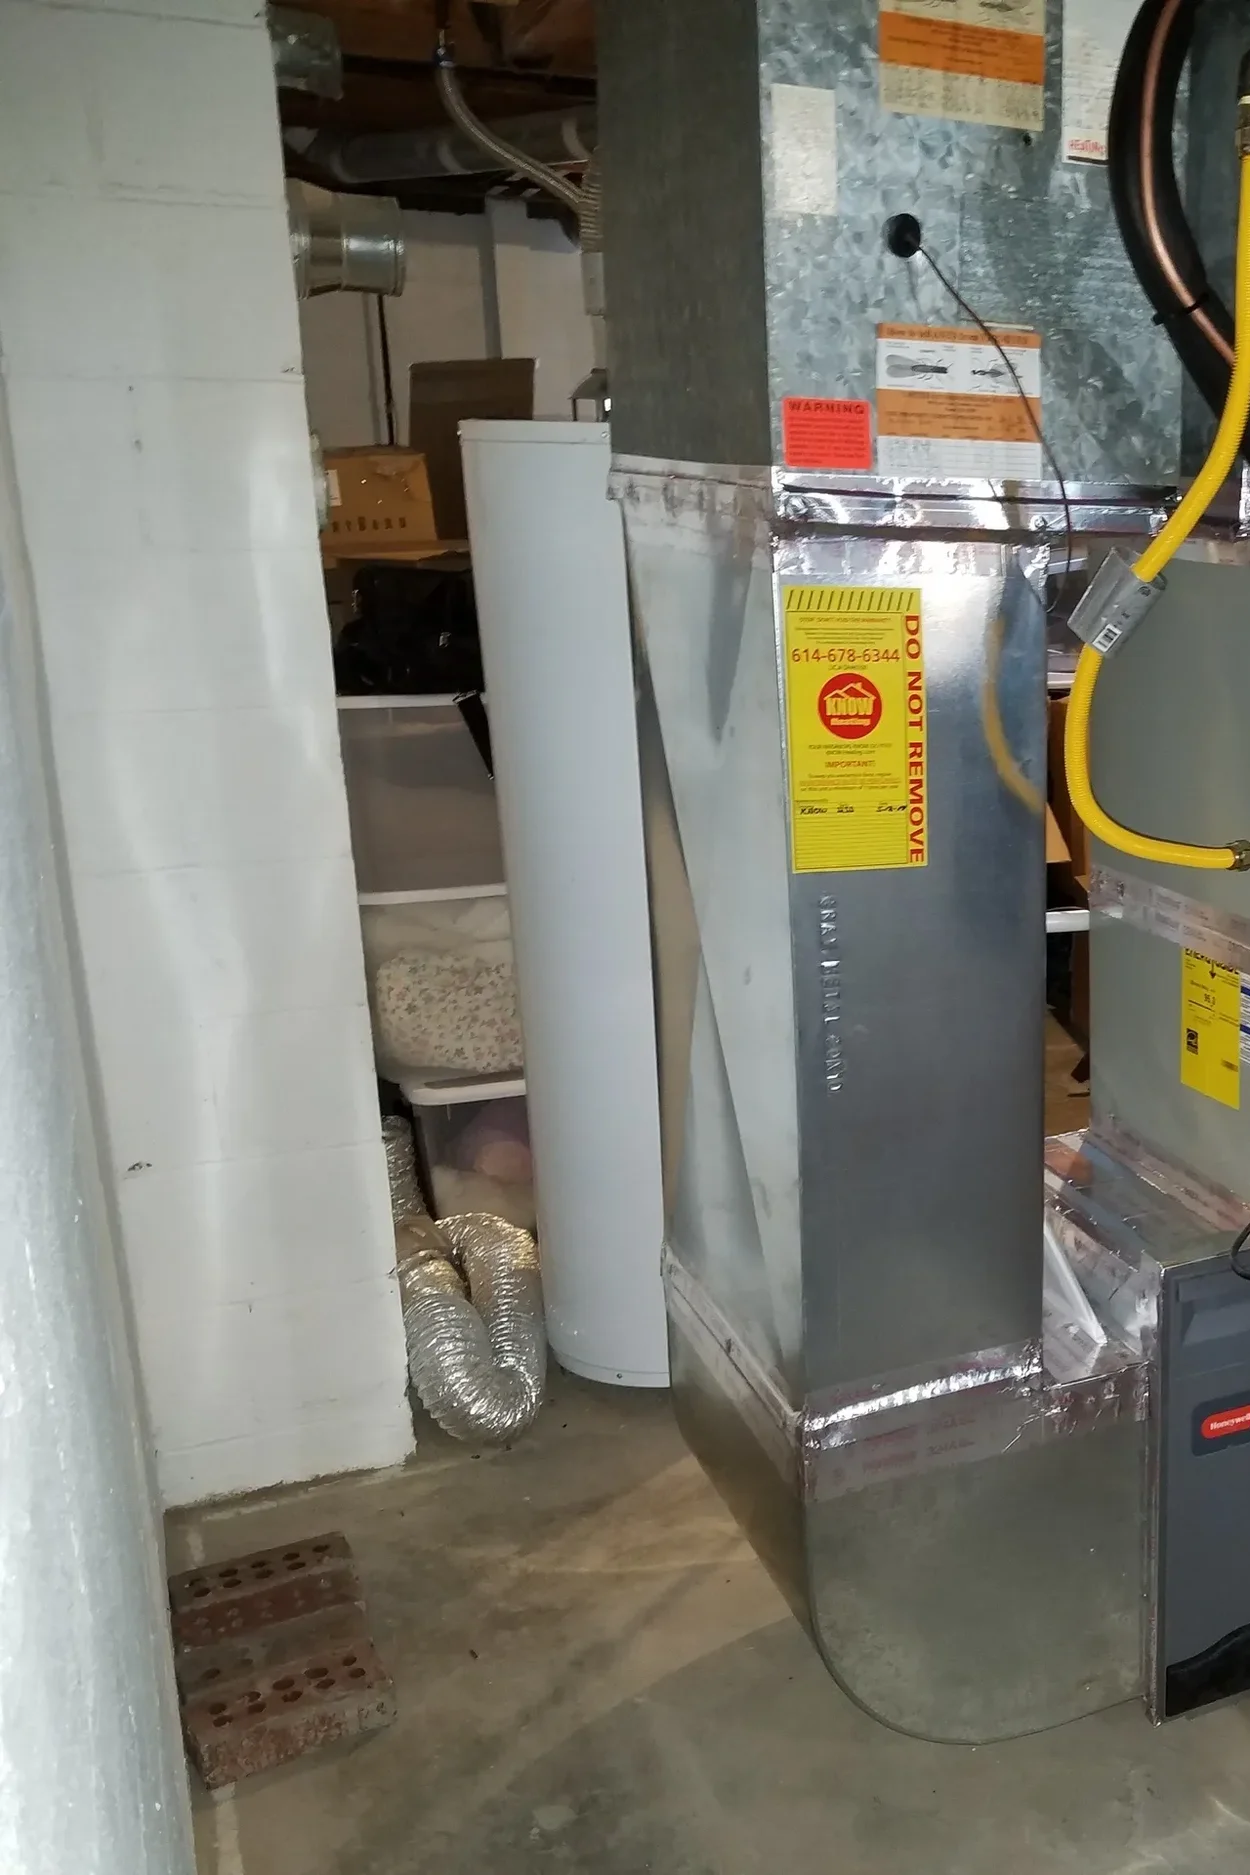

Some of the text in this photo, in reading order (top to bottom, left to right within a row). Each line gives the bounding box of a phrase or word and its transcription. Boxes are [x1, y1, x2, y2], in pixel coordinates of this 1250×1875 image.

[788, 401, 865, 415] WARNING
[791, 648, 901, 663] 614-678-6344
[905, 615, 924, 863] DO NOT REMOVE
